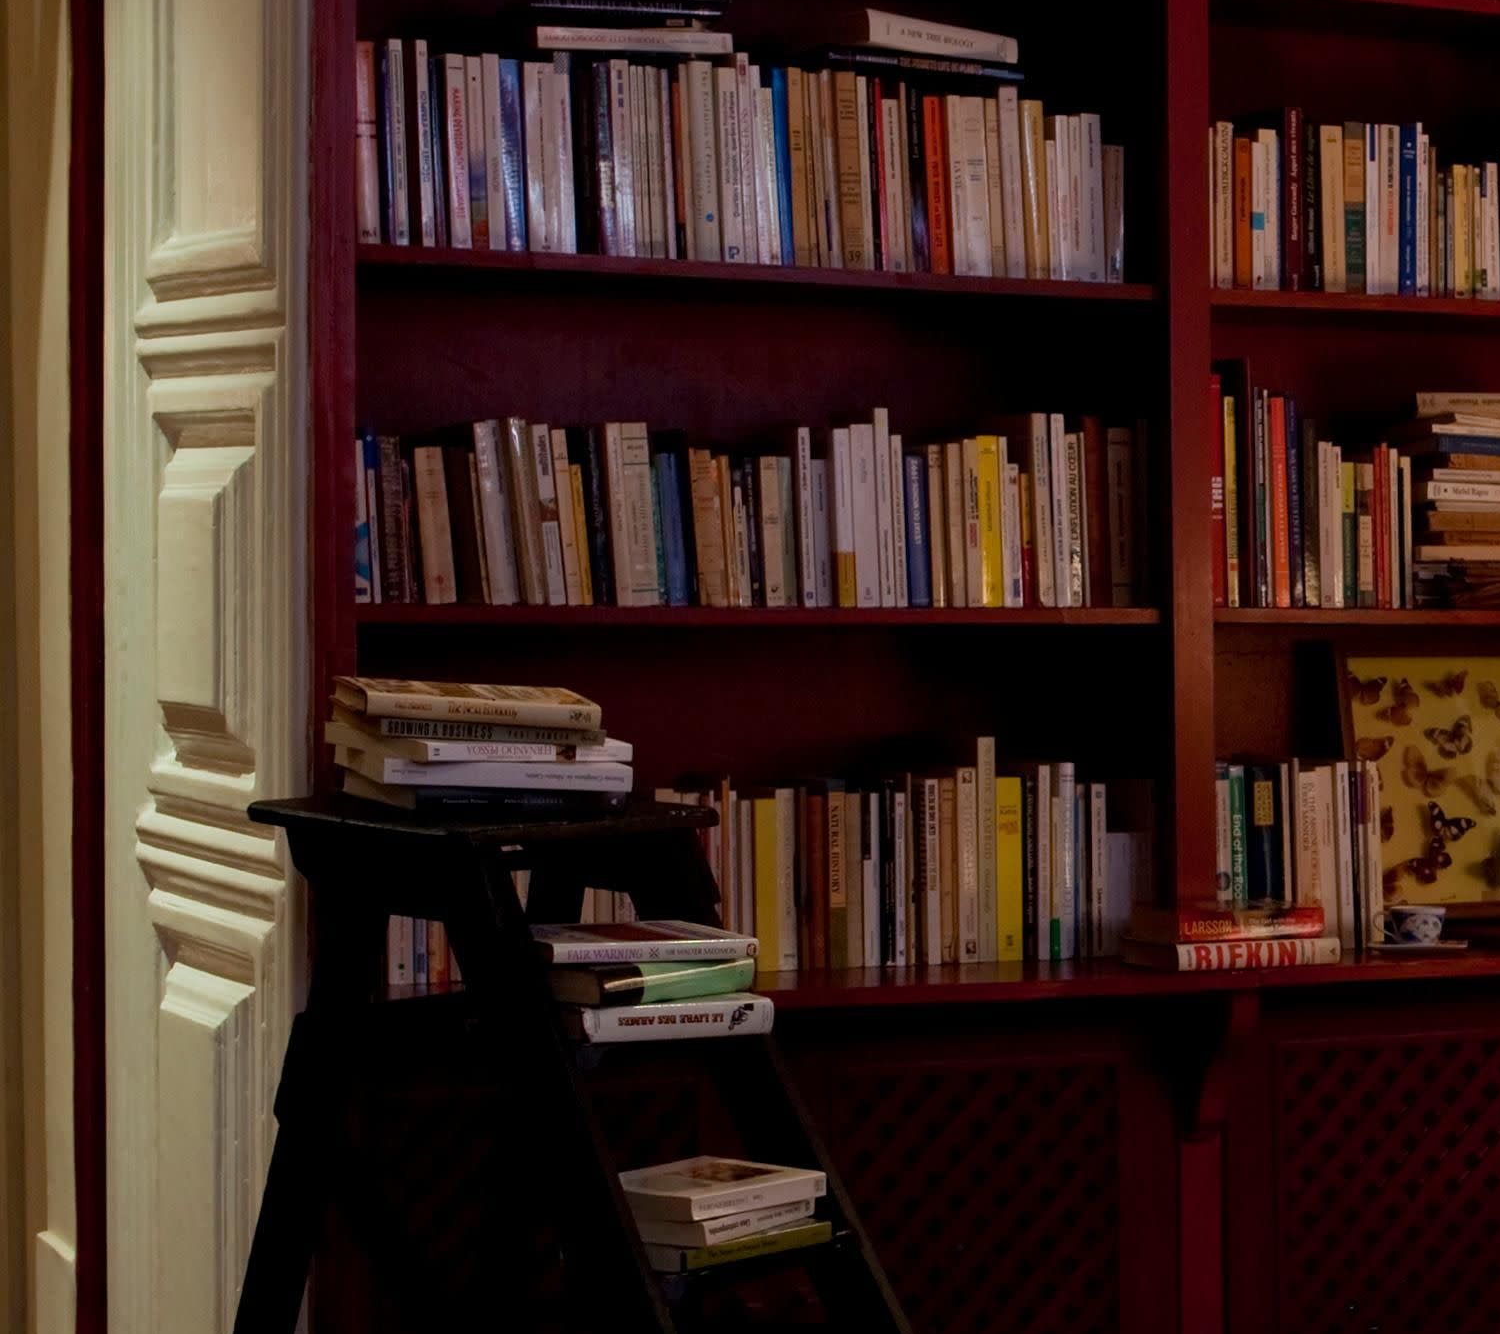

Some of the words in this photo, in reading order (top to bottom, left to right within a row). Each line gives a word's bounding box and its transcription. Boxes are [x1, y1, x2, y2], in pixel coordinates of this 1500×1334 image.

[1068, 474, 1077, 485] AU
[387, 719, 430, 738] GROWING
[442, 723, 493, 740] BUSINESS
[830, 806, 839, 848] NATURAL
[1233, 814, 1243, 837] End
[1234, 840, 1243, 851] of
[1234, 855, 1244, 873] the
[1185, 919, 1233, 936] LARSSON
[566, 949, 590, 962] FAIR
[592, 948, 643, 961] WARNING
[1194, 940, 1298, 970] RIFKIN
[658, 1015, 678, 1026] DES
[681, 1014, 706, 1025] LIVRE
[709, 1013, 724, 1023] LE
